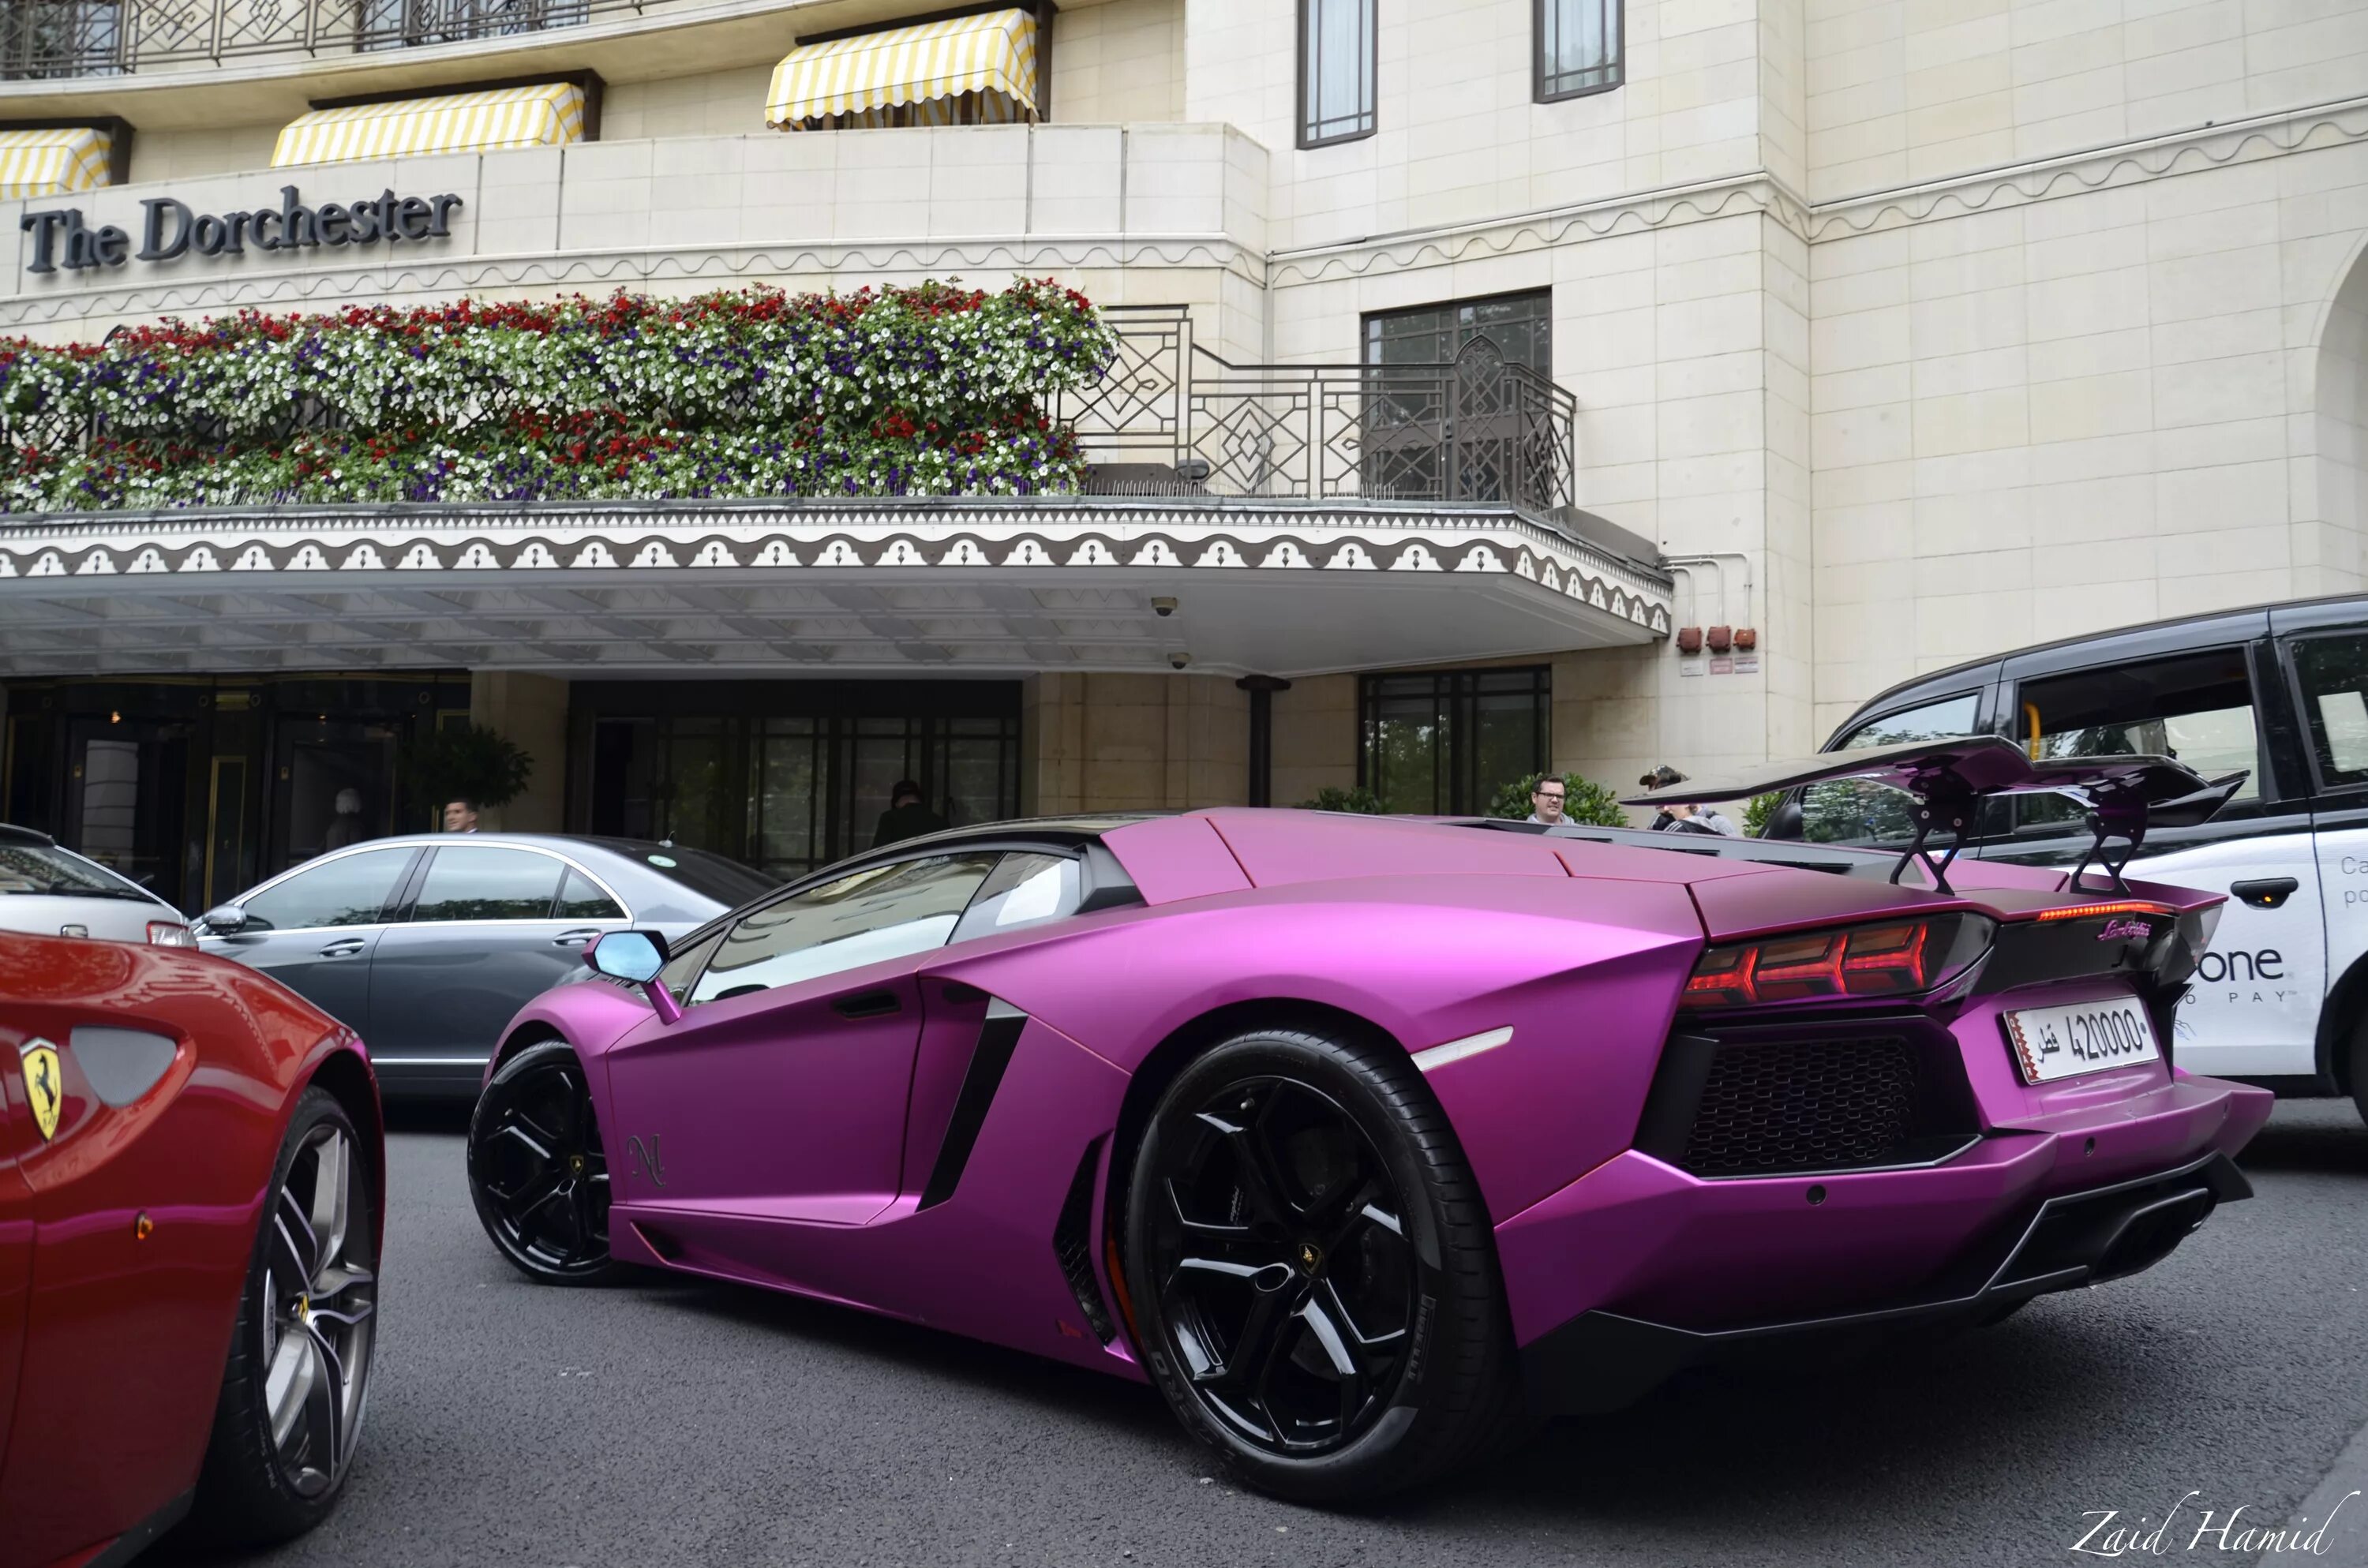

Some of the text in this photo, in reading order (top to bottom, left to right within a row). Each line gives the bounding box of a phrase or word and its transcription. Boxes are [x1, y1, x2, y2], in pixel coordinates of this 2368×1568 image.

[21, 185, 463, 274] The Dorchester
[2009, 1018, 2033, 1076] QATAR
[2066, 1009, 2143, 1061] 420000
